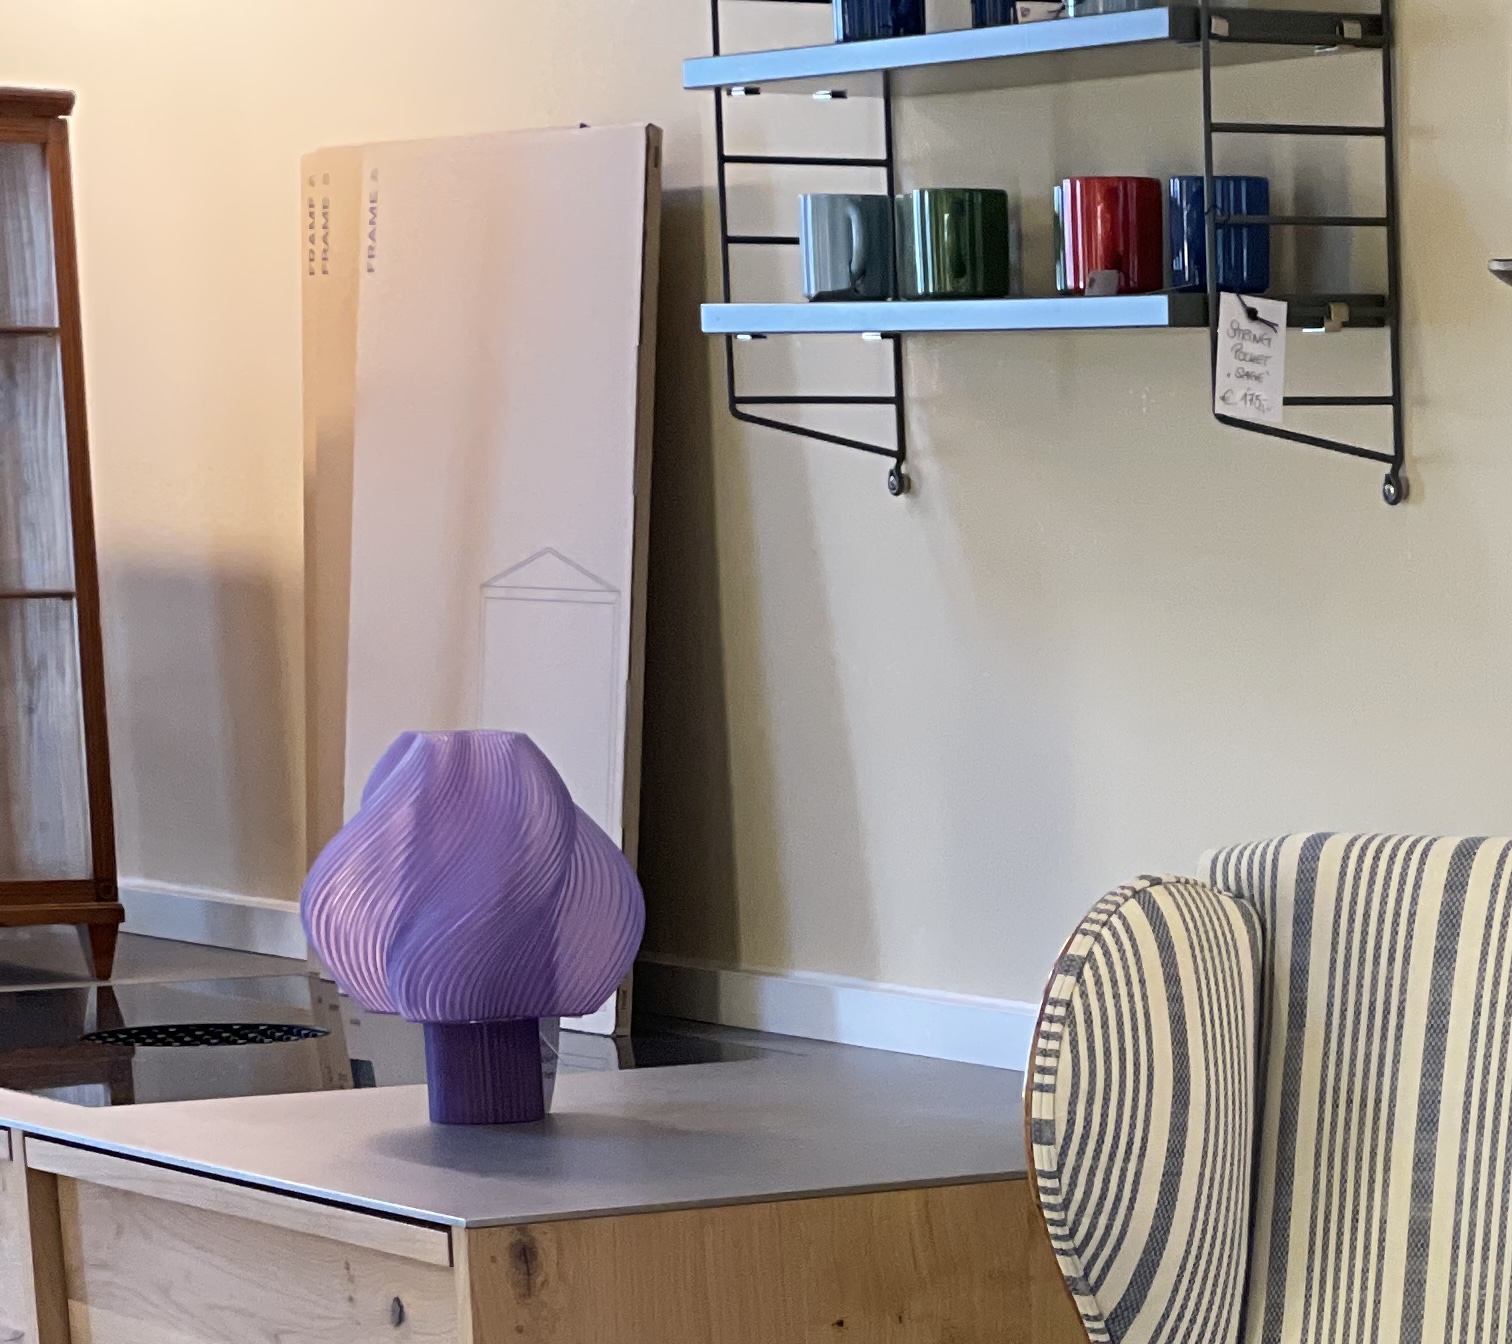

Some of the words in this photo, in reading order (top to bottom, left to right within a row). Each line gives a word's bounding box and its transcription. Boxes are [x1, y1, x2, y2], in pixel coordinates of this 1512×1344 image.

[321, 196, 330, 275] FRAME
[366, 190, 379, 273] FRAME
[1226, 318, 1272, 348] STRING
[1231, 342, 1273, 366] POCKET
